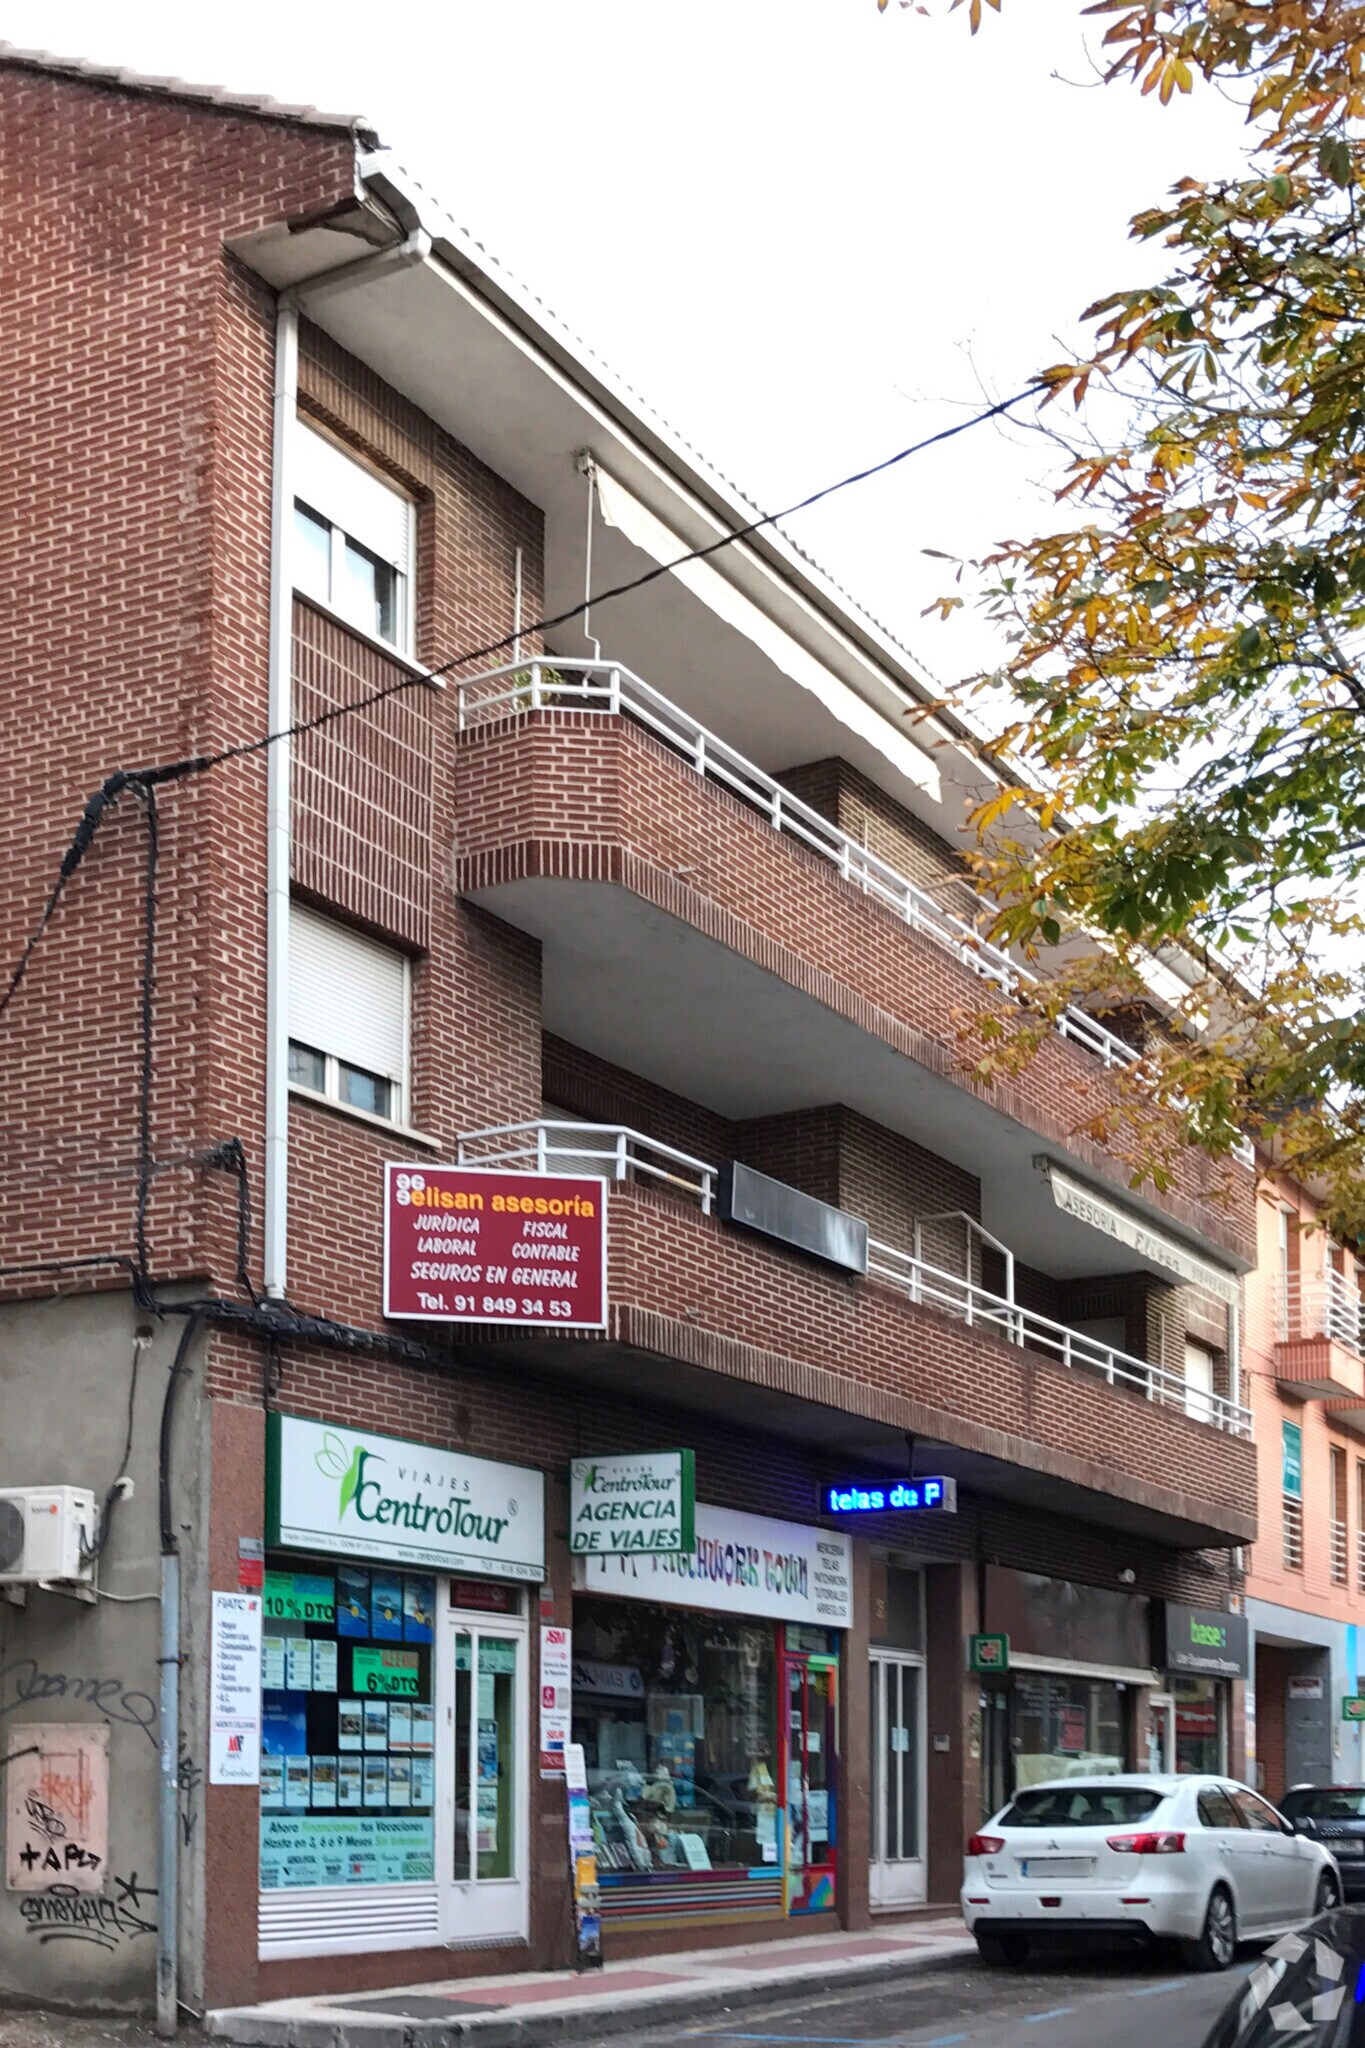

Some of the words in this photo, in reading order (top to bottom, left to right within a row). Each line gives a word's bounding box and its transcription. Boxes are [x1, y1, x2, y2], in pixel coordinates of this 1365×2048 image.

[491, 1194, 595, 1218] asesoría
[413, 1212, 480, 1234] JURÍDICA
[523, 1220, 568, 1239] FISCAL
[417, 1236, 477, 1256] LABORAL
[511, 1242, 580, 1262] CONTABLE
[410, 1261, 482, 1283] SEGUROS
[486, 1265, 507, 1284] EN
[511, 1268, 578, 1288] GENERAL
[416, 1292, 450, 1311] Tel.
[454, 1295, 475, 1312] 91
[482, 1296, 517, 1314] 849
[522, 1298, 544, 1315] 34
[549, 1300, 572, 1317] 53
[398, 1467, 472, 1492] VIAJES
[590, 1473, 676, 1494] CentroTour
[830, 1488, 884, 1511] telas
[924, 1482, 940, 1506] P
[355, 1480, 509, 1545] CentroTour
[577, 1499, 676, 1522] AGENCIA
[573, 1531, 601, 1550] DE
[610, 1528, 682, 1549] VIAJES
[304, 1602, 334, 1620] DTO
